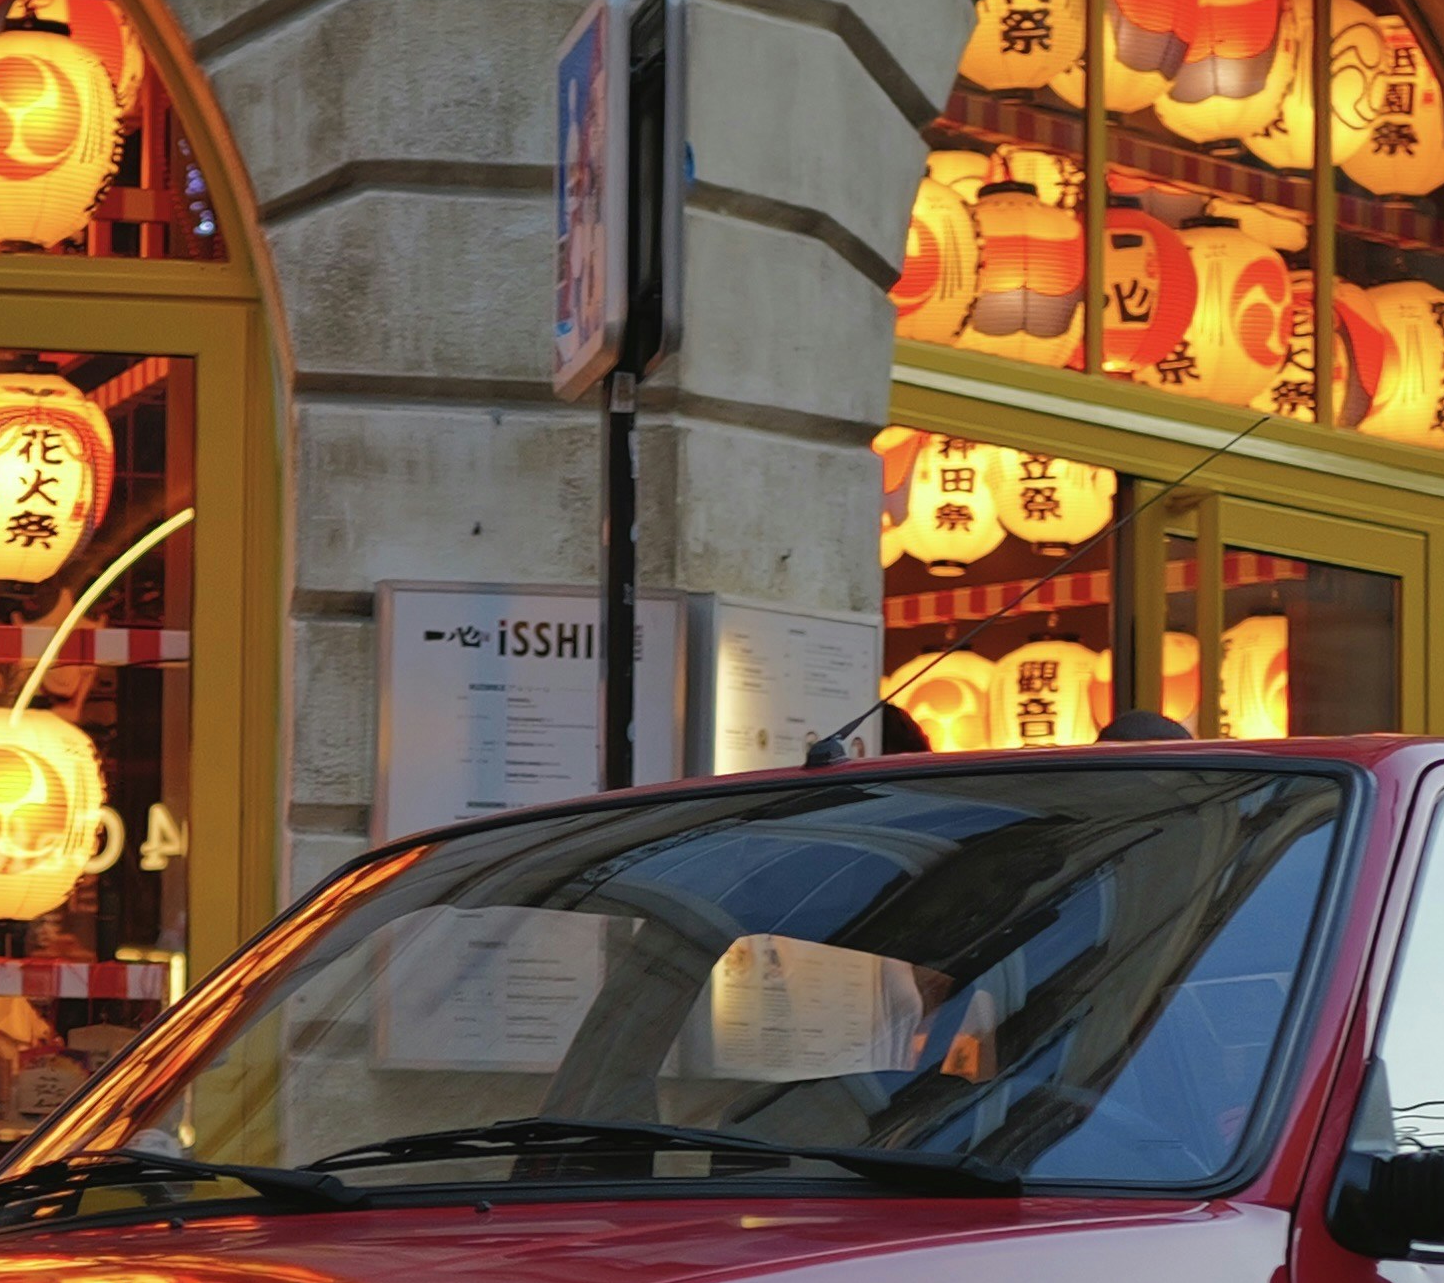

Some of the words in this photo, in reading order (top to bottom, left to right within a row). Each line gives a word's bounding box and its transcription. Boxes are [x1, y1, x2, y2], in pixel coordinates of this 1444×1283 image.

[6, 428, 60, 549] 花火祭
[498, 620, 594, 658] iSSHI
[1018, 660, 1060, 746] 観音
